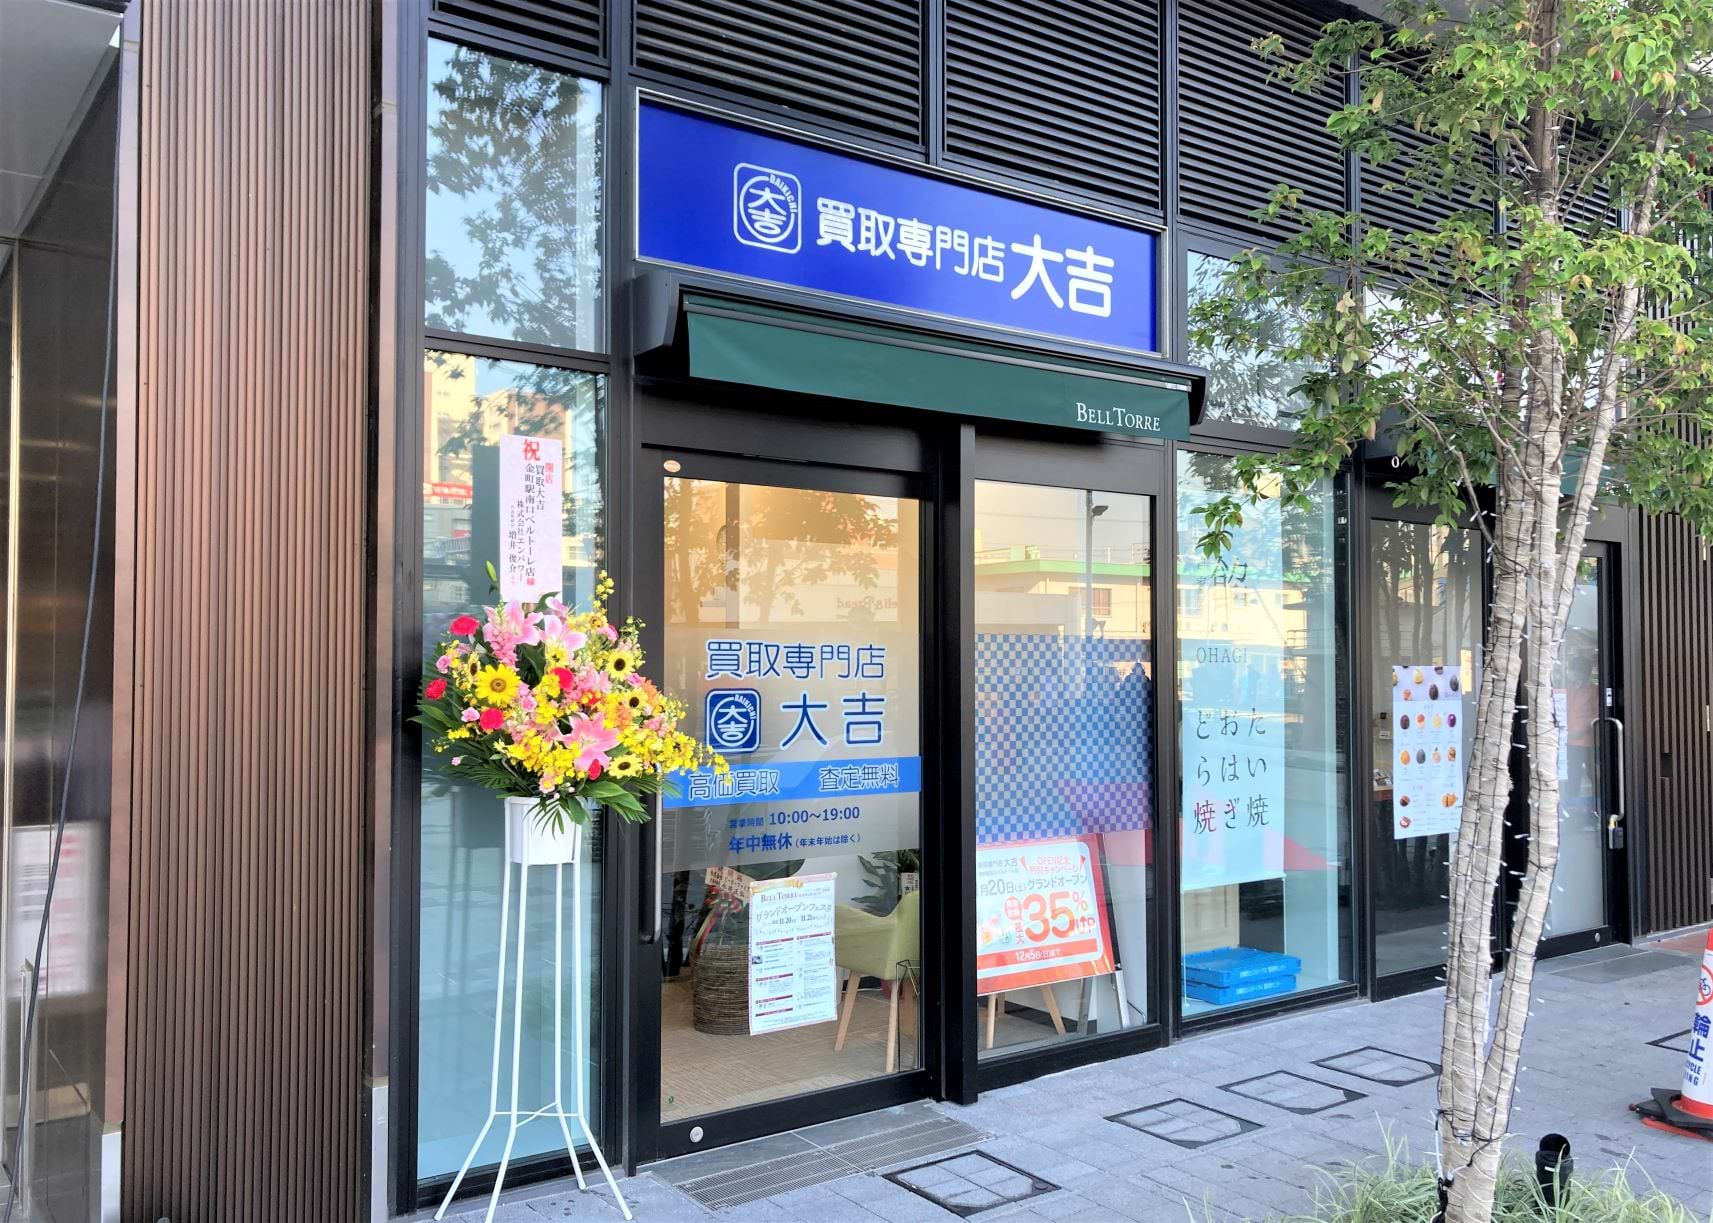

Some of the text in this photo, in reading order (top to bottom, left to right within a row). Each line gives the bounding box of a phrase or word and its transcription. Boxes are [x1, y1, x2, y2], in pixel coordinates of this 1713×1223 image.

[747, 186, 788, 235] 大吉
[769, 173, 798, 213] DAIKICHI
[816, 197, 1115, 317] 買取専門店 大吉
[1076, 402, 1161, 432] BELL TORRE
[522, 438, 541, 461] 祝
[535, 464, 545, 511] 買取大吉
[705, 640, 886, 679] 買取専門店
[1196, 647, 1248, 664] OHAGI
[717, 704, 749, 741] 大吉
[734, 694, 757, 719] DAIKICHI
[780, 692, 885, 749] 大吉
[688, 763, 900, 801] 高価買取 査定無料
[1193, 711, 1217, 834] どら焼
[1219, 709, 1240, 830] おはぎ
[1247, 707, 1271, 828] たい焼
[729, 832, 793, 855] 年中無休
